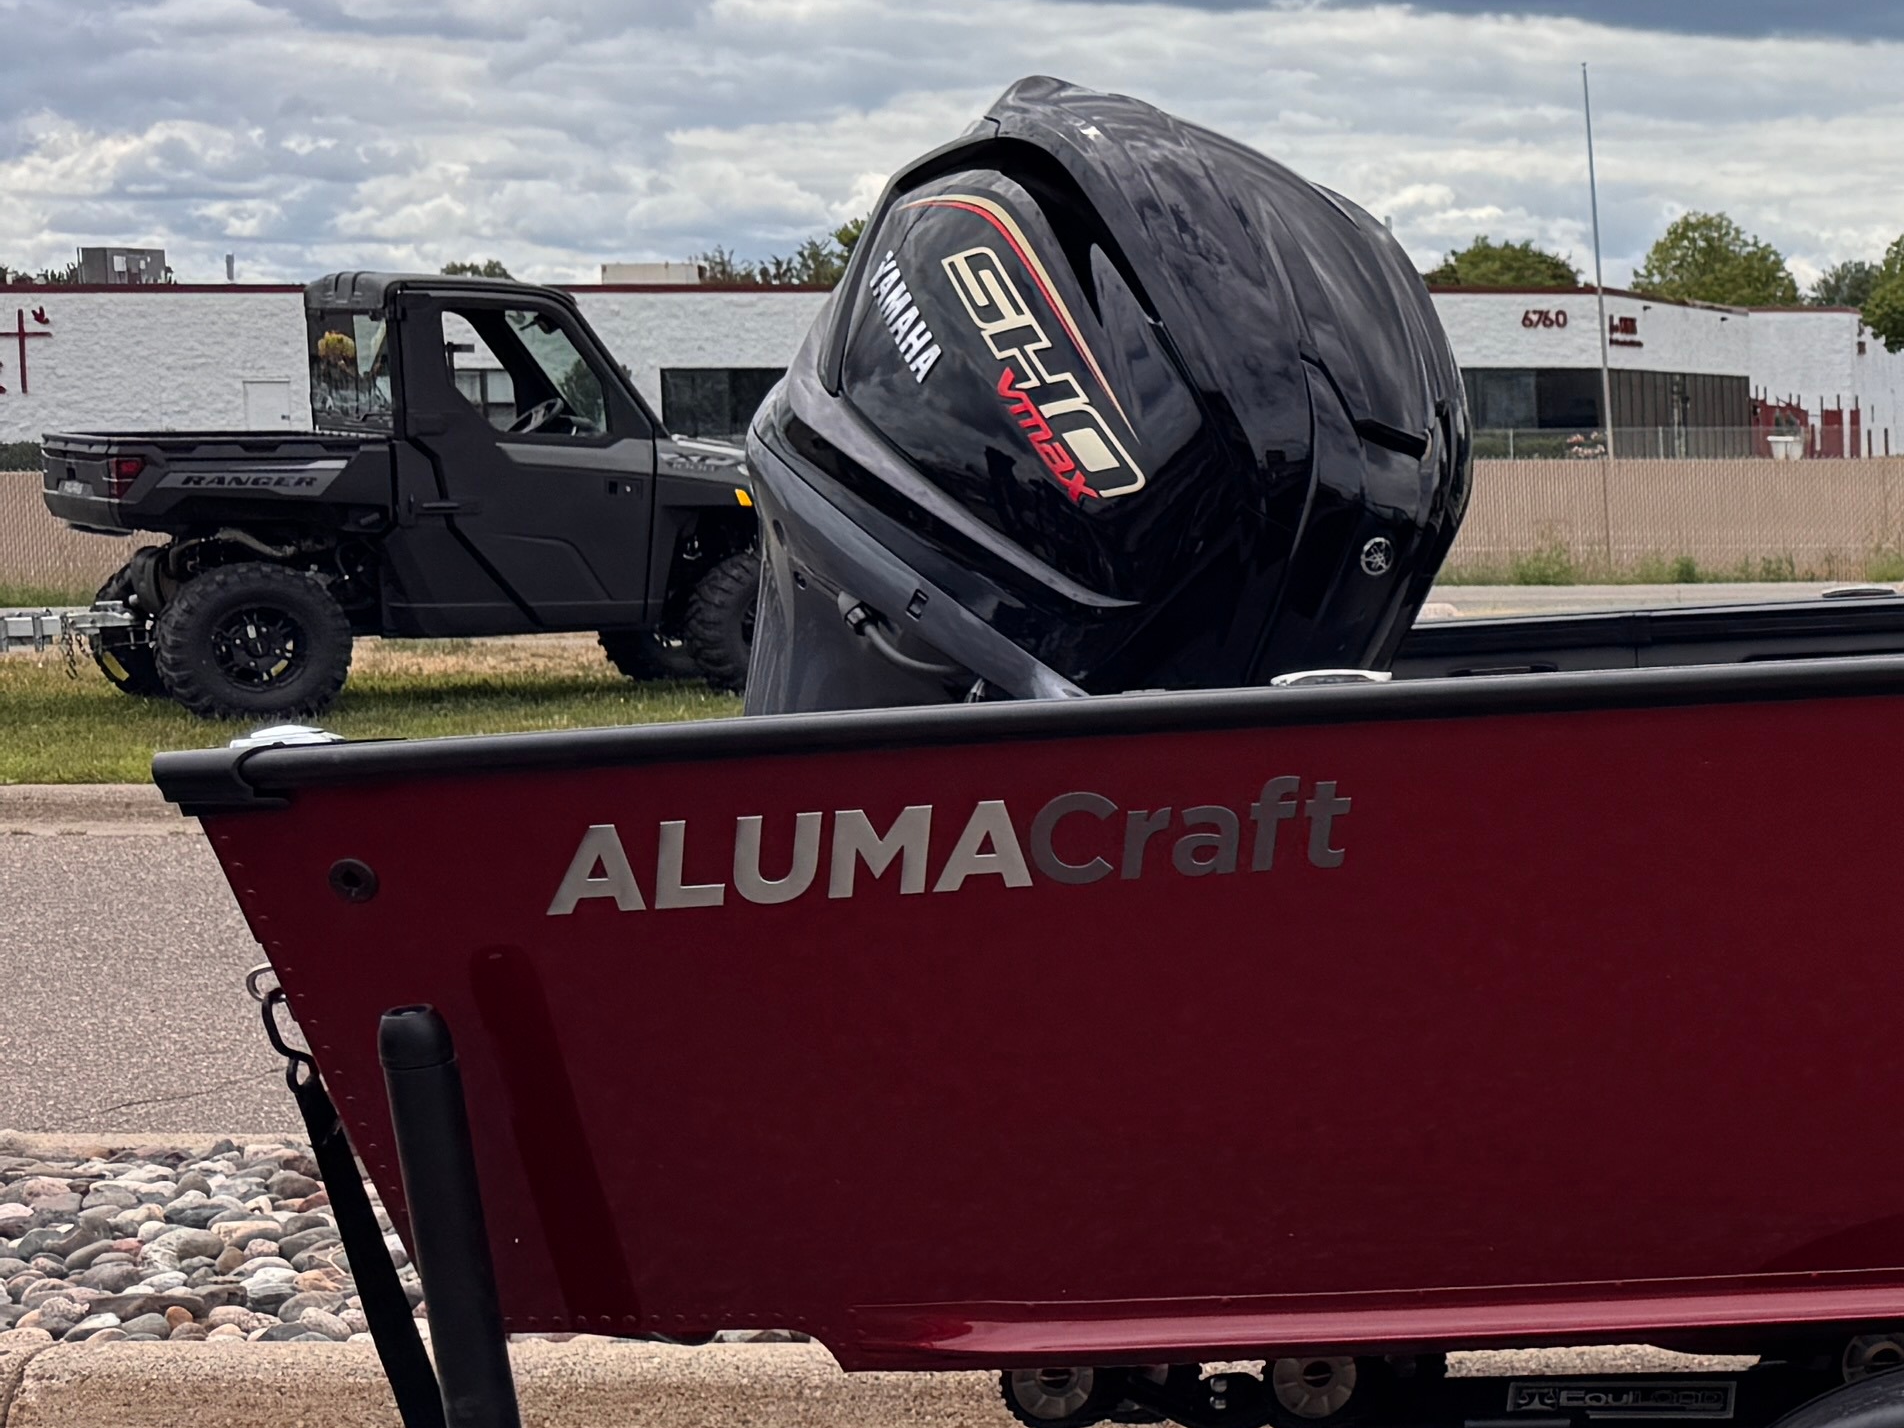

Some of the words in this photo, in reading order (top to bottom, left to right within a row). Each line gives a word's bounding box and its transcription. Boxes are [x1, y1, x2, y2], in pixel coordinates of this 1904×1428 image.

[869, 250, 943, 384] YAMAHA
[941, 246, 1146, 498] SHO
[1521, 310, 1568, 329] 6760
[181, 475, 318, 487] RANGER
[545, 775, 1352, 917] ALUMACraft
